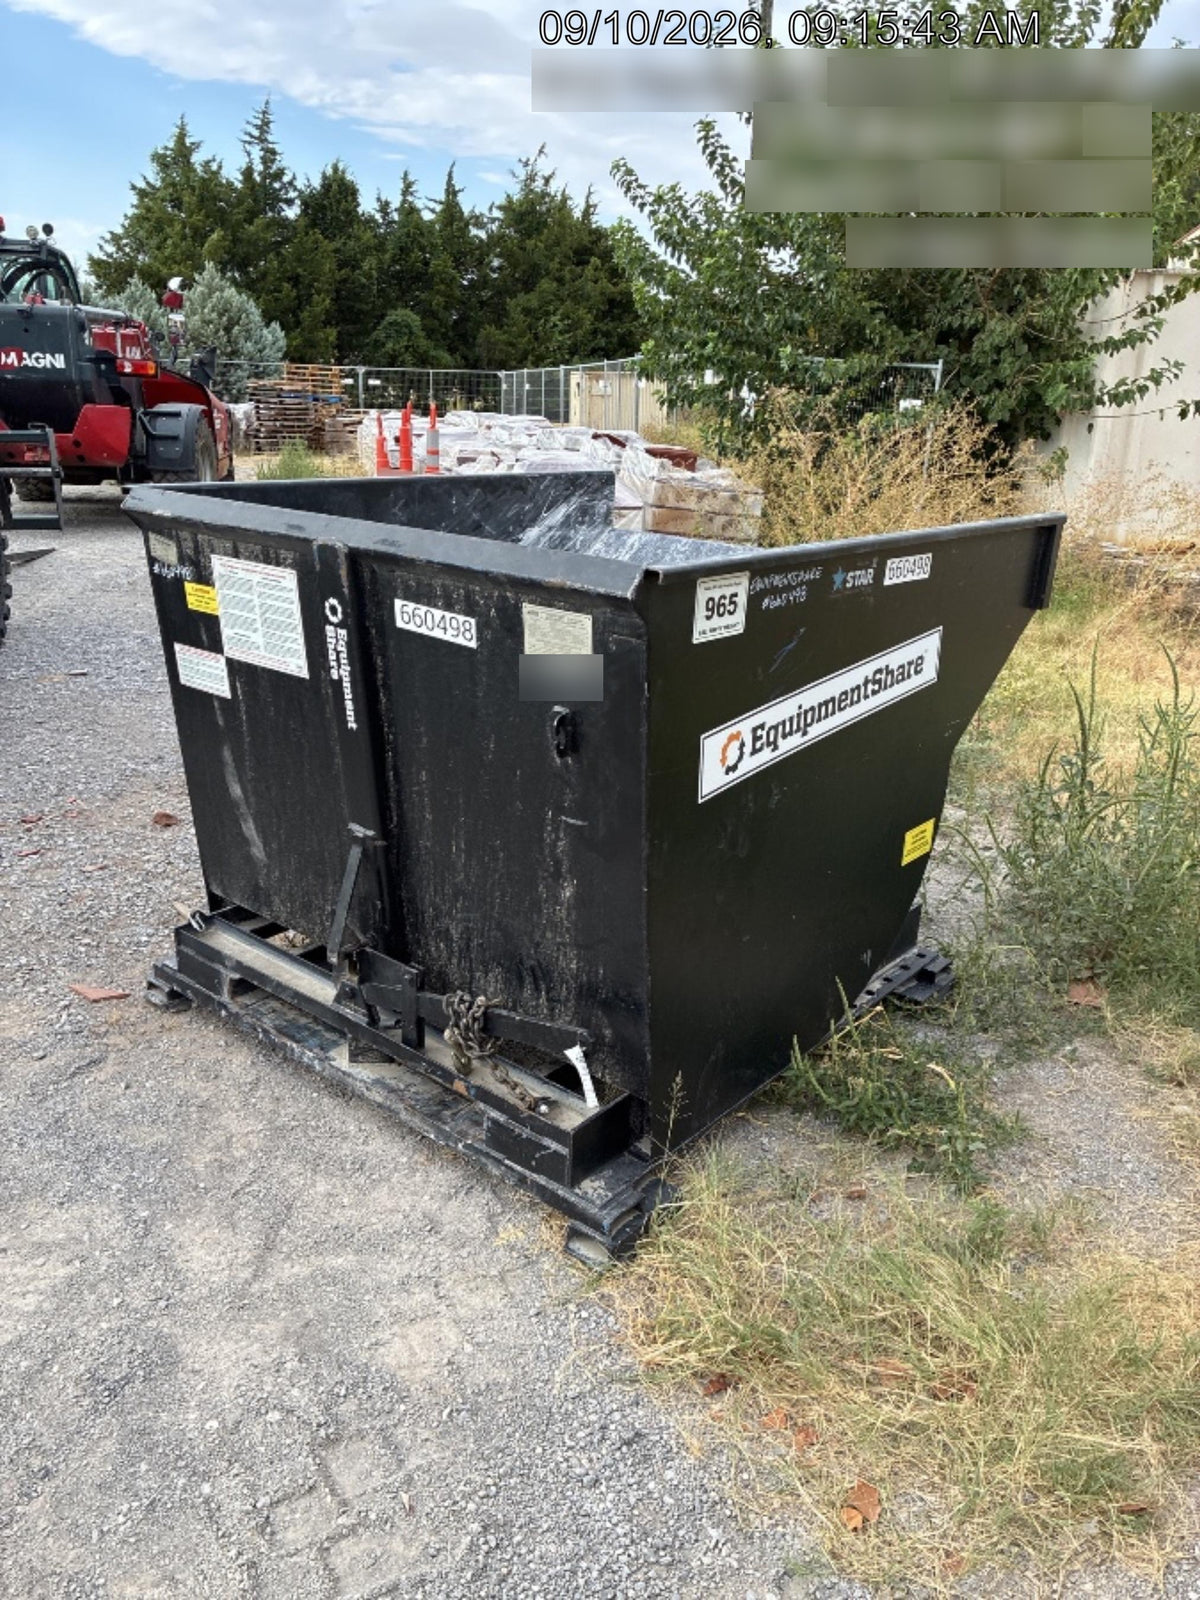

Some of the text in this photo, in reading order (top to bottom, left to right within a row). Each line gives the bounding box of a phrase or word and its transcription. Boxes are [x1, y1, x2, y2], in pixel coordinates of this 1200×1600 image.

[0, 351, 66, 369] MAGNI
[845, 568, 874, 588] STAR
[888, 556, 931, 580] 660498
[400, 603, 474, 642] 660498
[705, 592, 739, 621] 965
[325, 624, 339, 680] Share
[336, 627, 358, 732] Equipment
[750, 654, 925, 757] EquipmentShare
